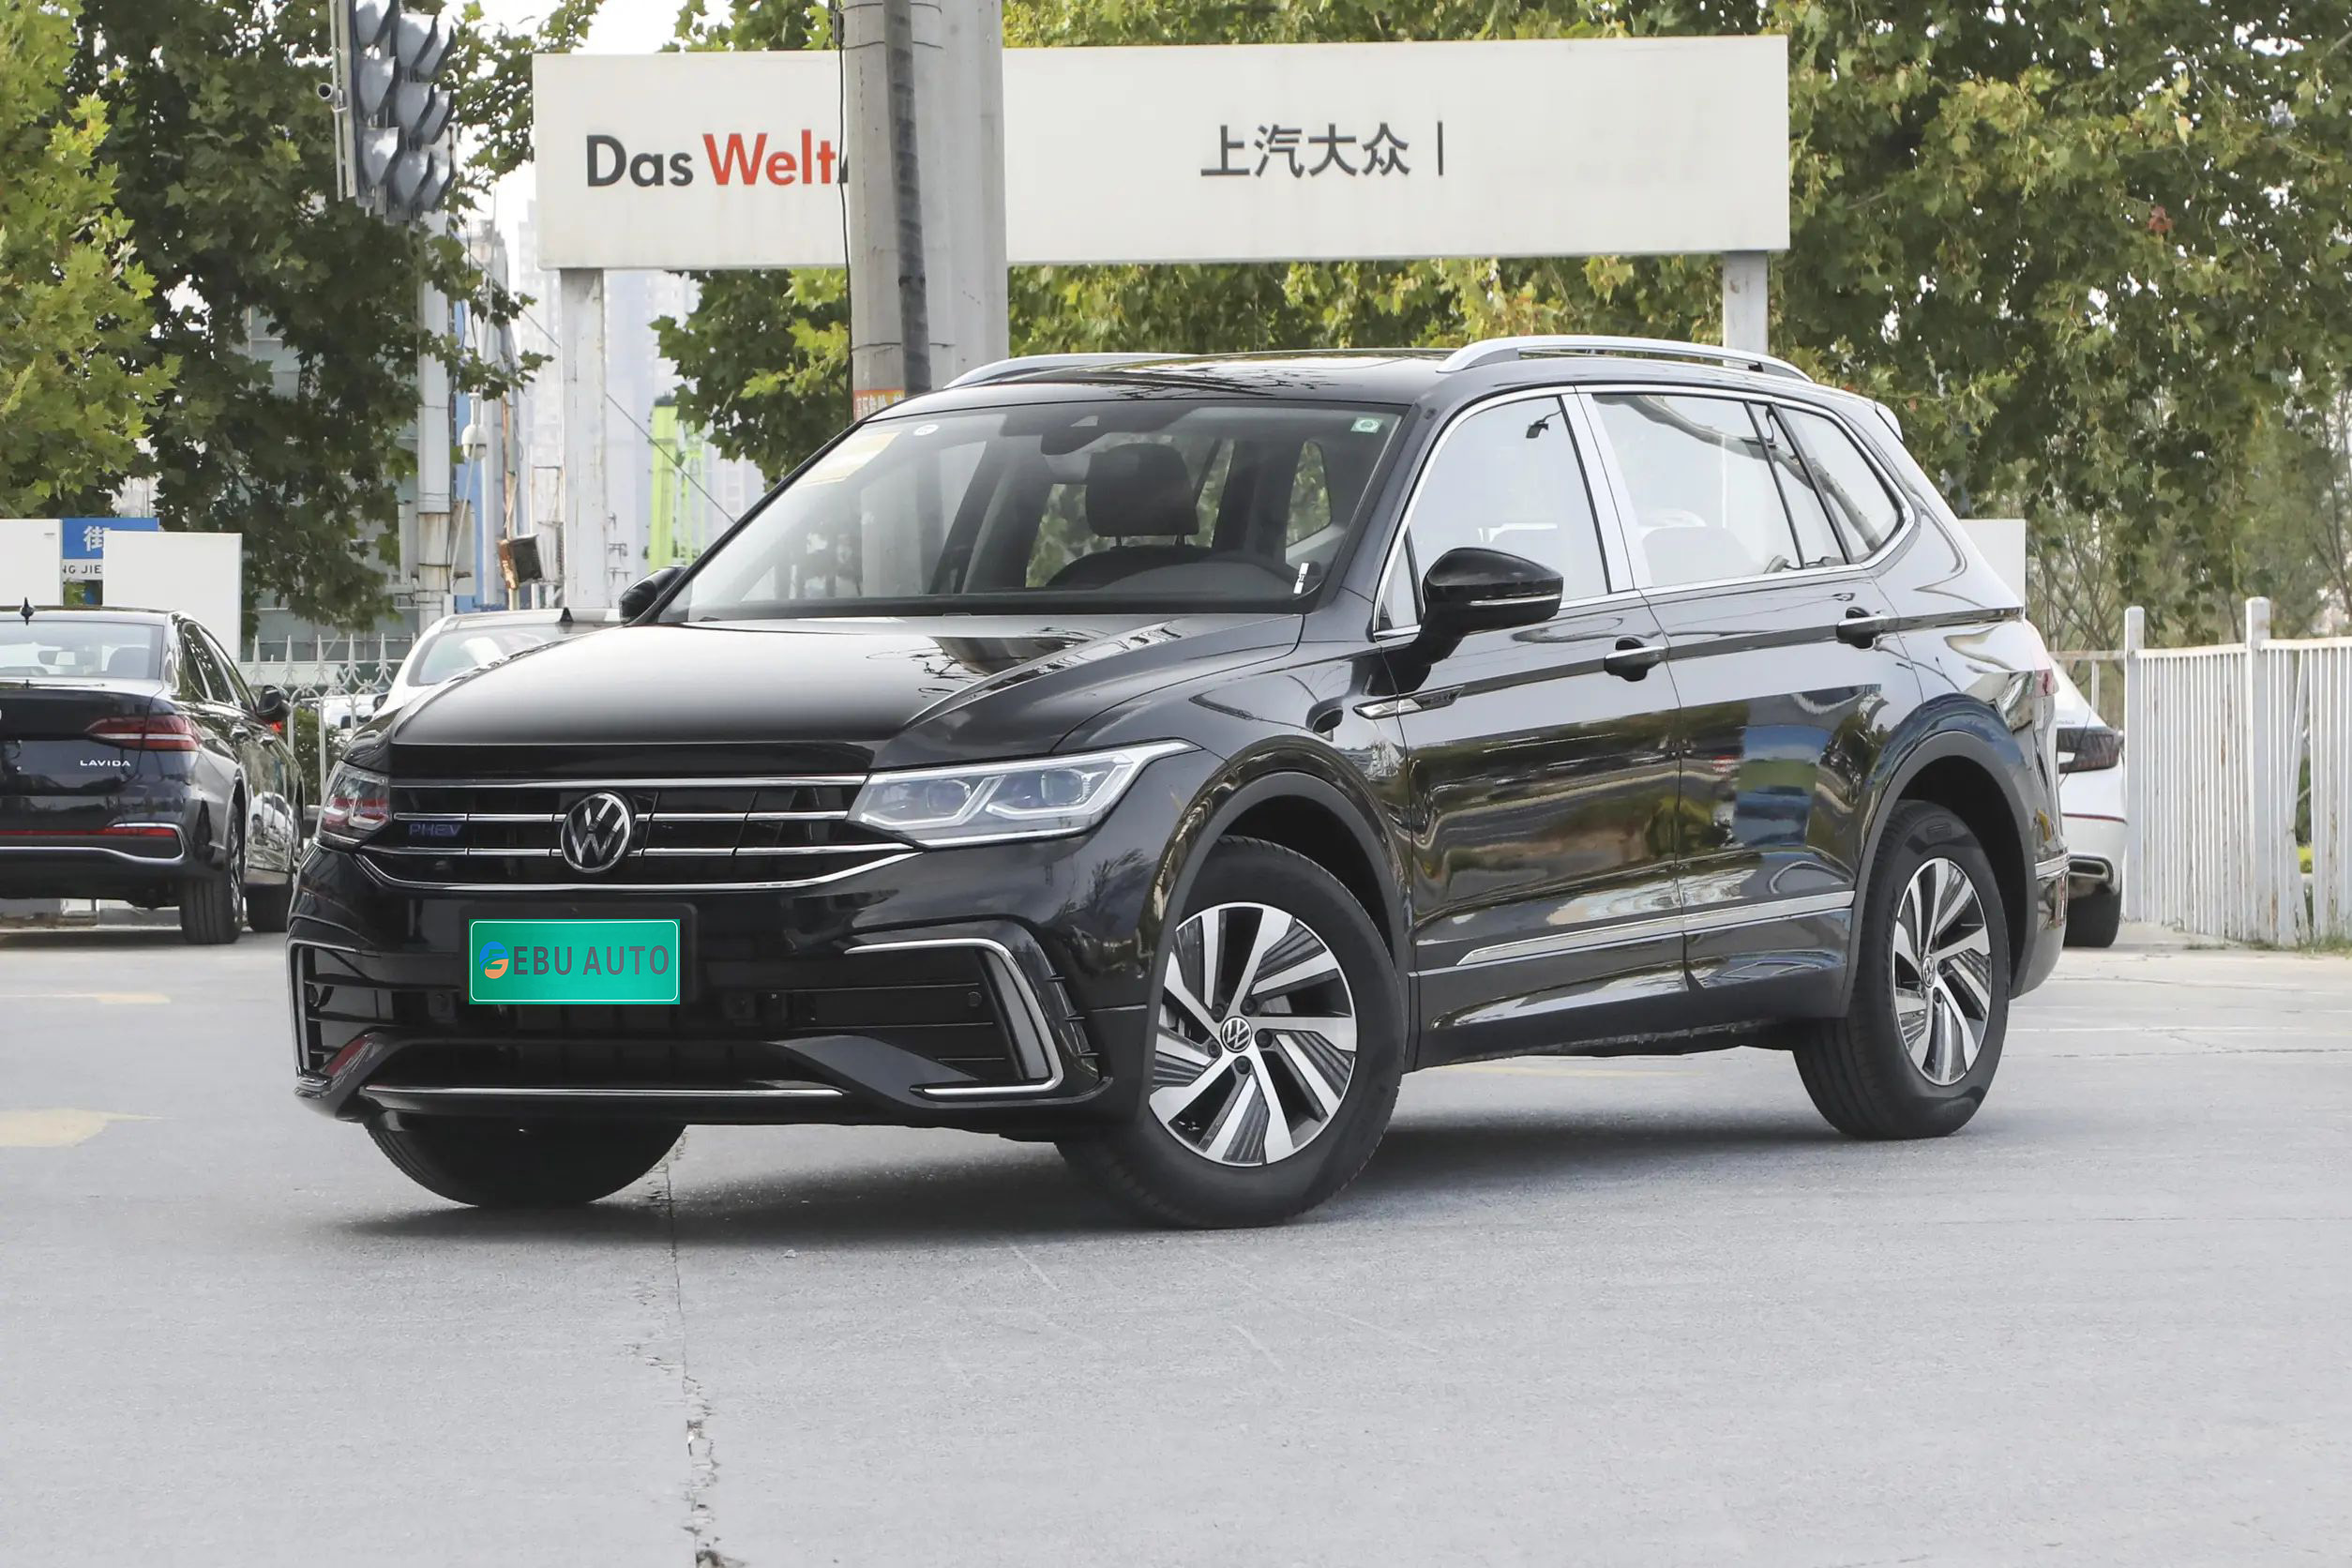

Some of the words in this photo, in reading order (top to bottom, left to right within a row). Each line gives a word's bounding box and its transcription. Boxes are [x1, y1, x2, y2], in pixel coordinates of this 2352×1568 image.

[587, 134, 694, 187] Das
[702, 129, 848, 186] Welt
[1200, 122, 1410, 178] 上汽大众
[82, 565, 102, 574] JIE
[409, 823, 461, 836] PHEV
